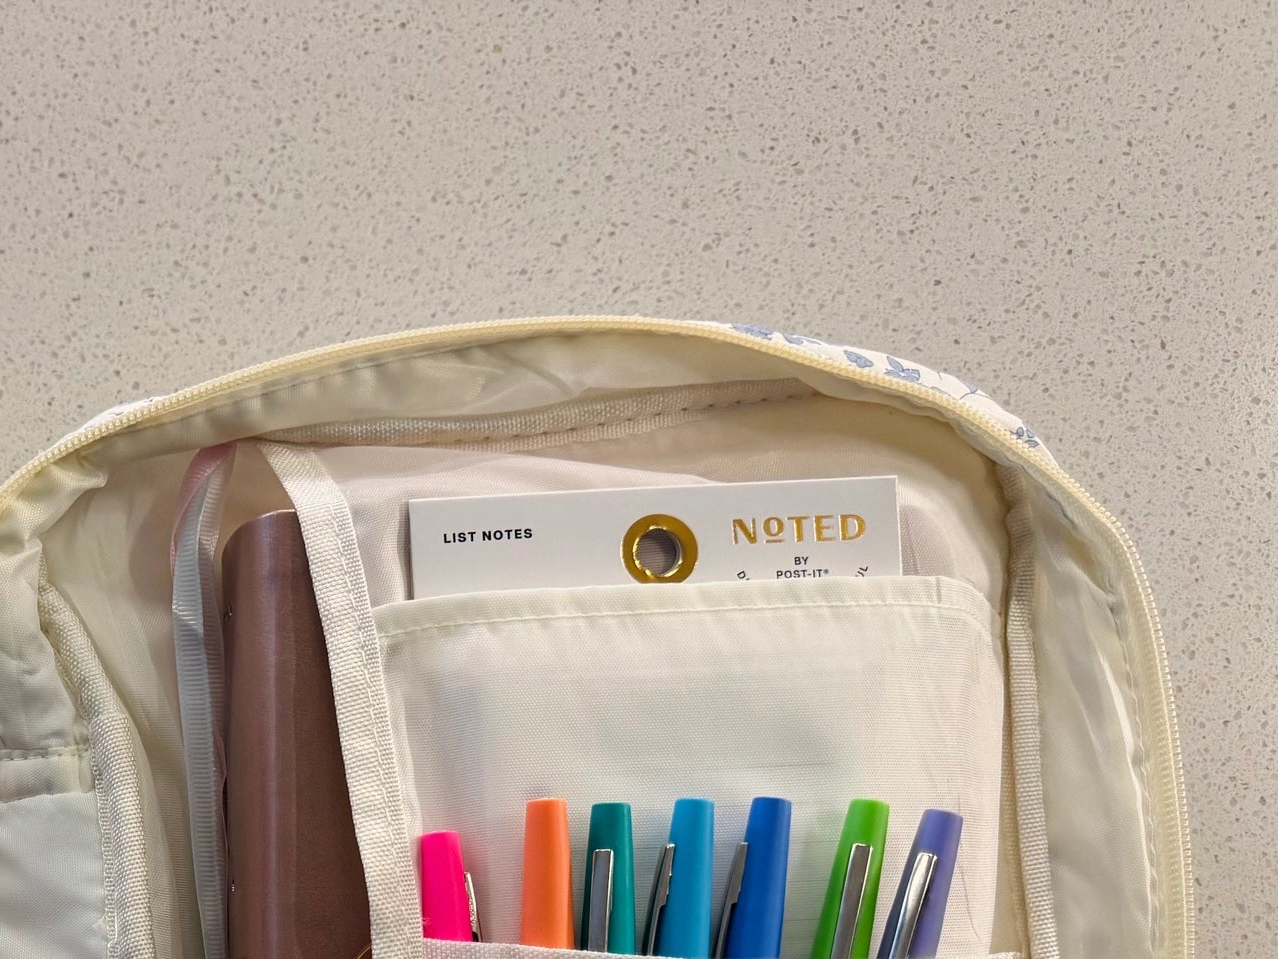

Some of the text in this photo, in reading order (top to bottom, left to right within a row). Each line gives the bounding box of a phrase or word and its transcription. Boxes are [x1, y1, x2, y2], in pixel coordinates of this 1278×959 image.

[443, 528, 533, 544] LIST NOTES
[794, 556, 809, 566] BY
